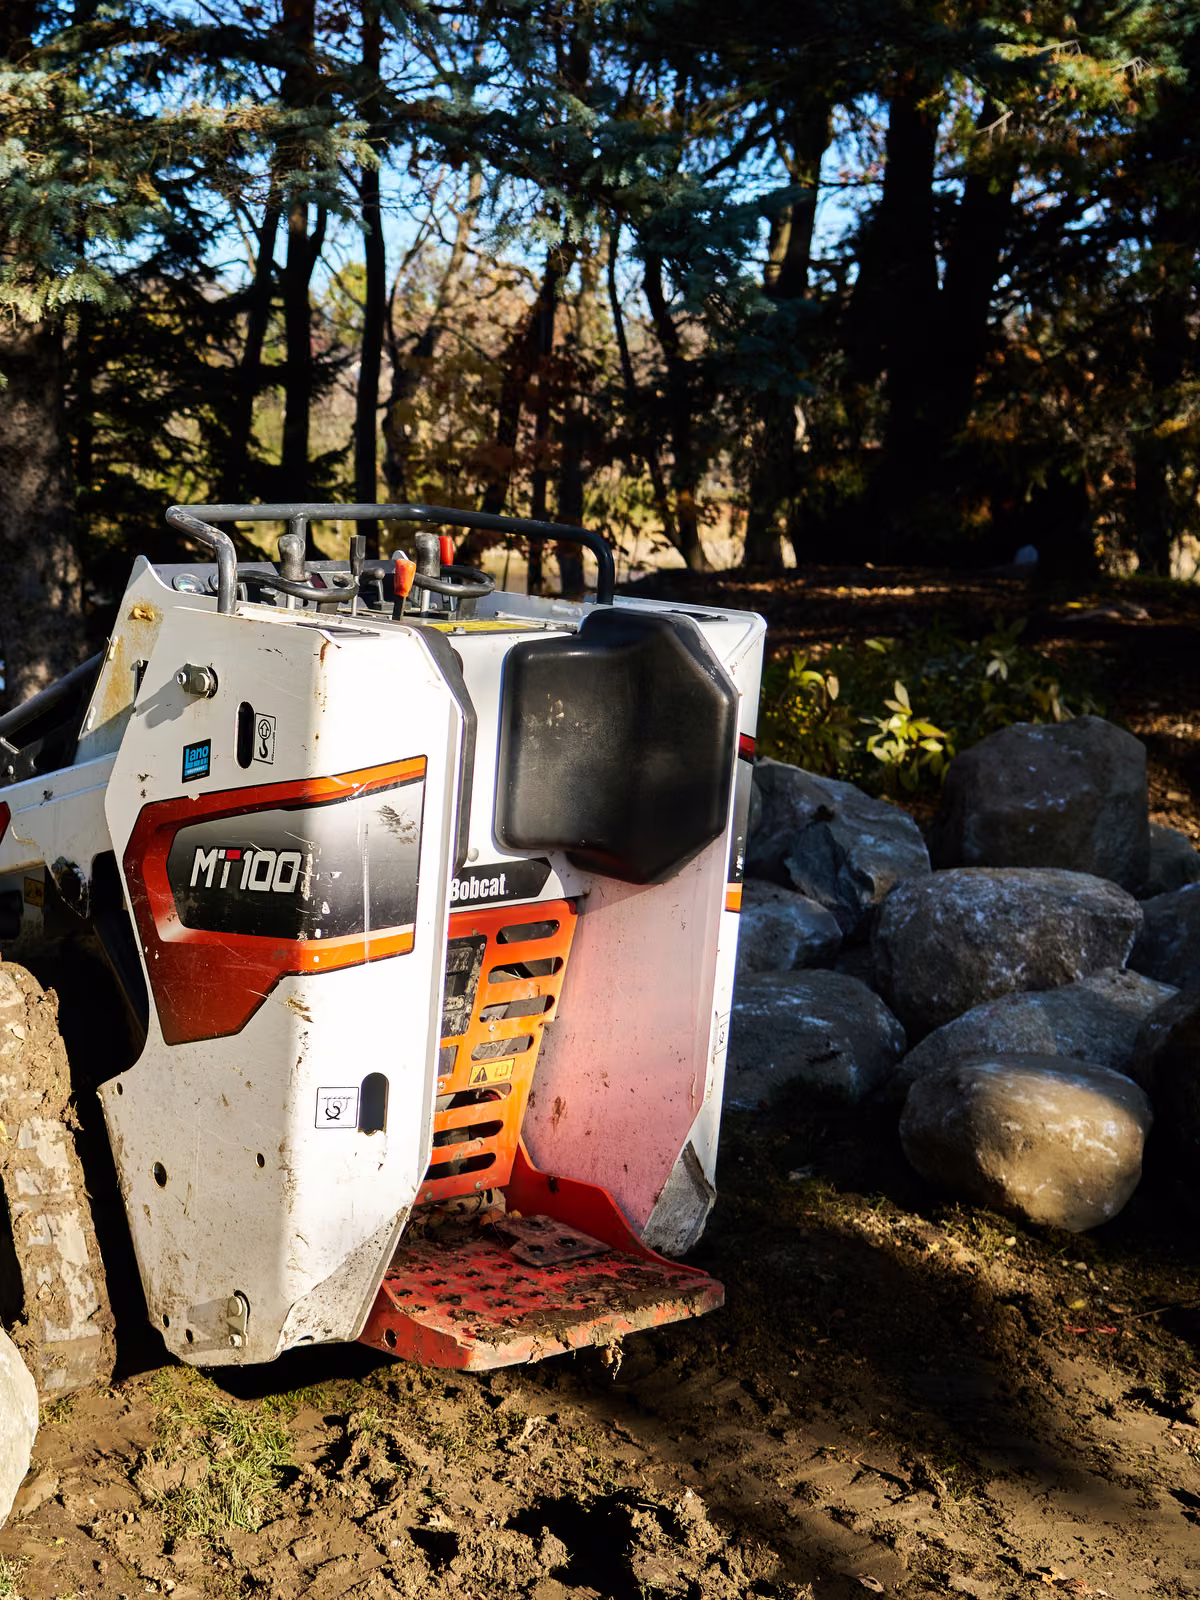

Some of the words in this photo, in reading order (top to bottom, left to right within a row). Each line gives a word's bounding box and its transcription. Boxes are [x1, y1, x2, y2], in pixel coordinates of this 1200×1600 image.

[185, 745, 209, 769] Lano
[189, 848, 302, 893] MT100
[450, 873, 506, 901] Bobcat
